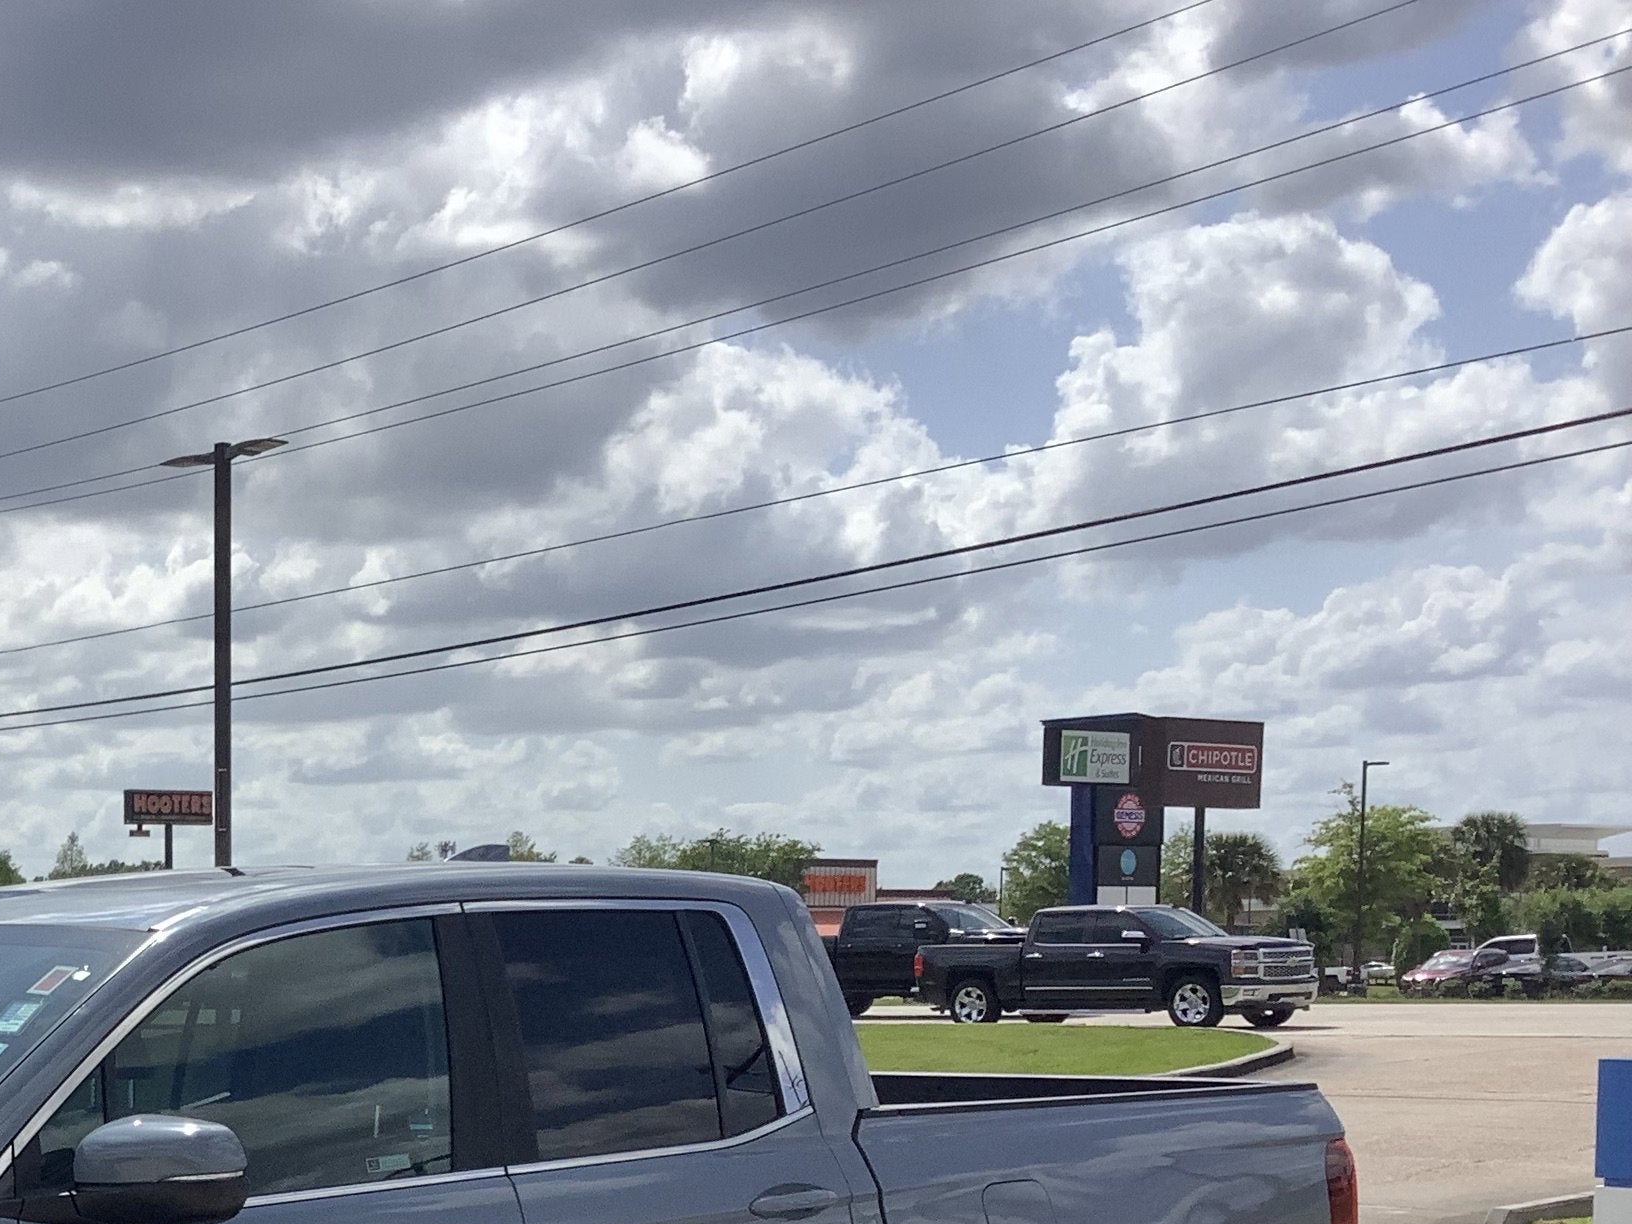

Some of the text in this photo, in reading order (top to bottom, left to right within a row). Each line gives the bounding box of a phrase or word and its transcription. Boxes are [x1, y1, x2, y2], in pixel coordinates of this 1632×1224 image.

[1089, 748, 1127, 767] Express
[1188, 749, 1253, 766] CHIPOTLE
[1197, 774, 1252, 785] MEXICAN GRILL
[133, 793, 212, 814] HOOTERS
